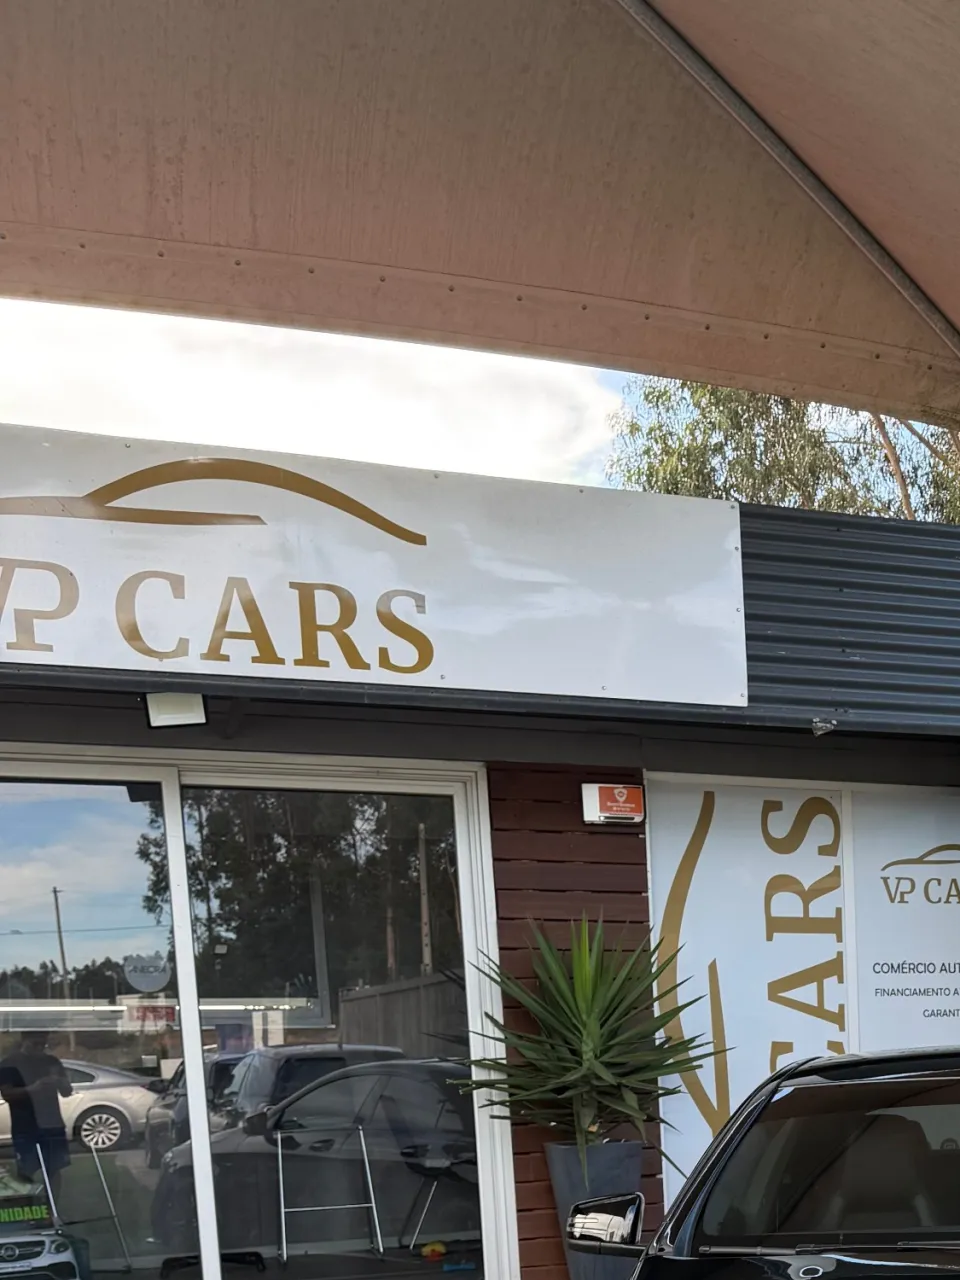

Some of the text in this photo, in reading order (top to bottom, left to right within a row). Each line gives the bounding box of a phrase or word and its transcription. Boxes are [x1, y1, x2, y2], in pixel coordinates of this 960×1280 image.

[115, 570, 435, 674] CARS
[880, 876, 916, 904] VP
[872, 960, 937, 974] COMÉRCIO
[874, 987, 951, 997] FINANCIAMENTO
